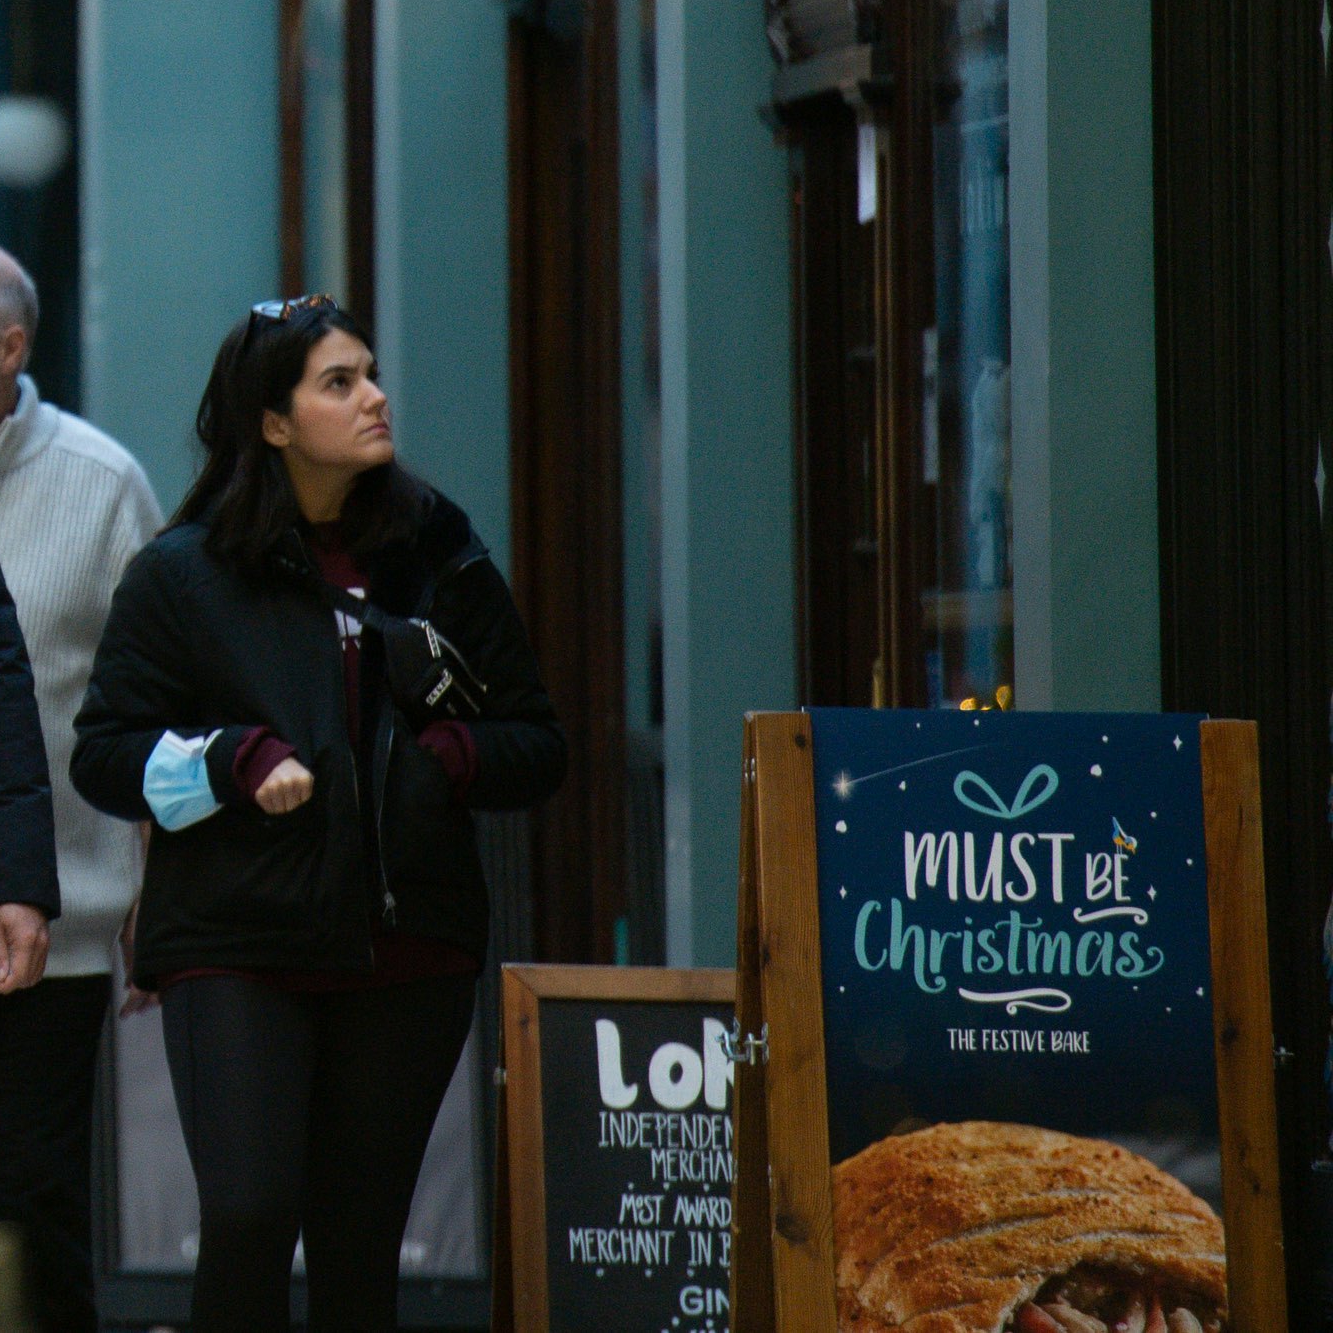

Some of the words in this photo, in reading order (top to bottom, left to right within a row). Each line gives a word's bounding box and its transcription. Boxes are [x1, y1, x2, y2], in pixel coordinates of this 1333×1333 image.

[903, 830, 1075, 903] MUST
[1086, 852, 1132, 902] BE
[854, 897, 1165, 994] Christmas
[946, 1028, 978, 1052] THE
[982, 1029, 1046, 1053] FESTIVE
[1050, 1030, 1091, 1054] BAKE
[568, 1227, 676, 1265] MERCHANT
[688, 1230, 712, 1267] IN
